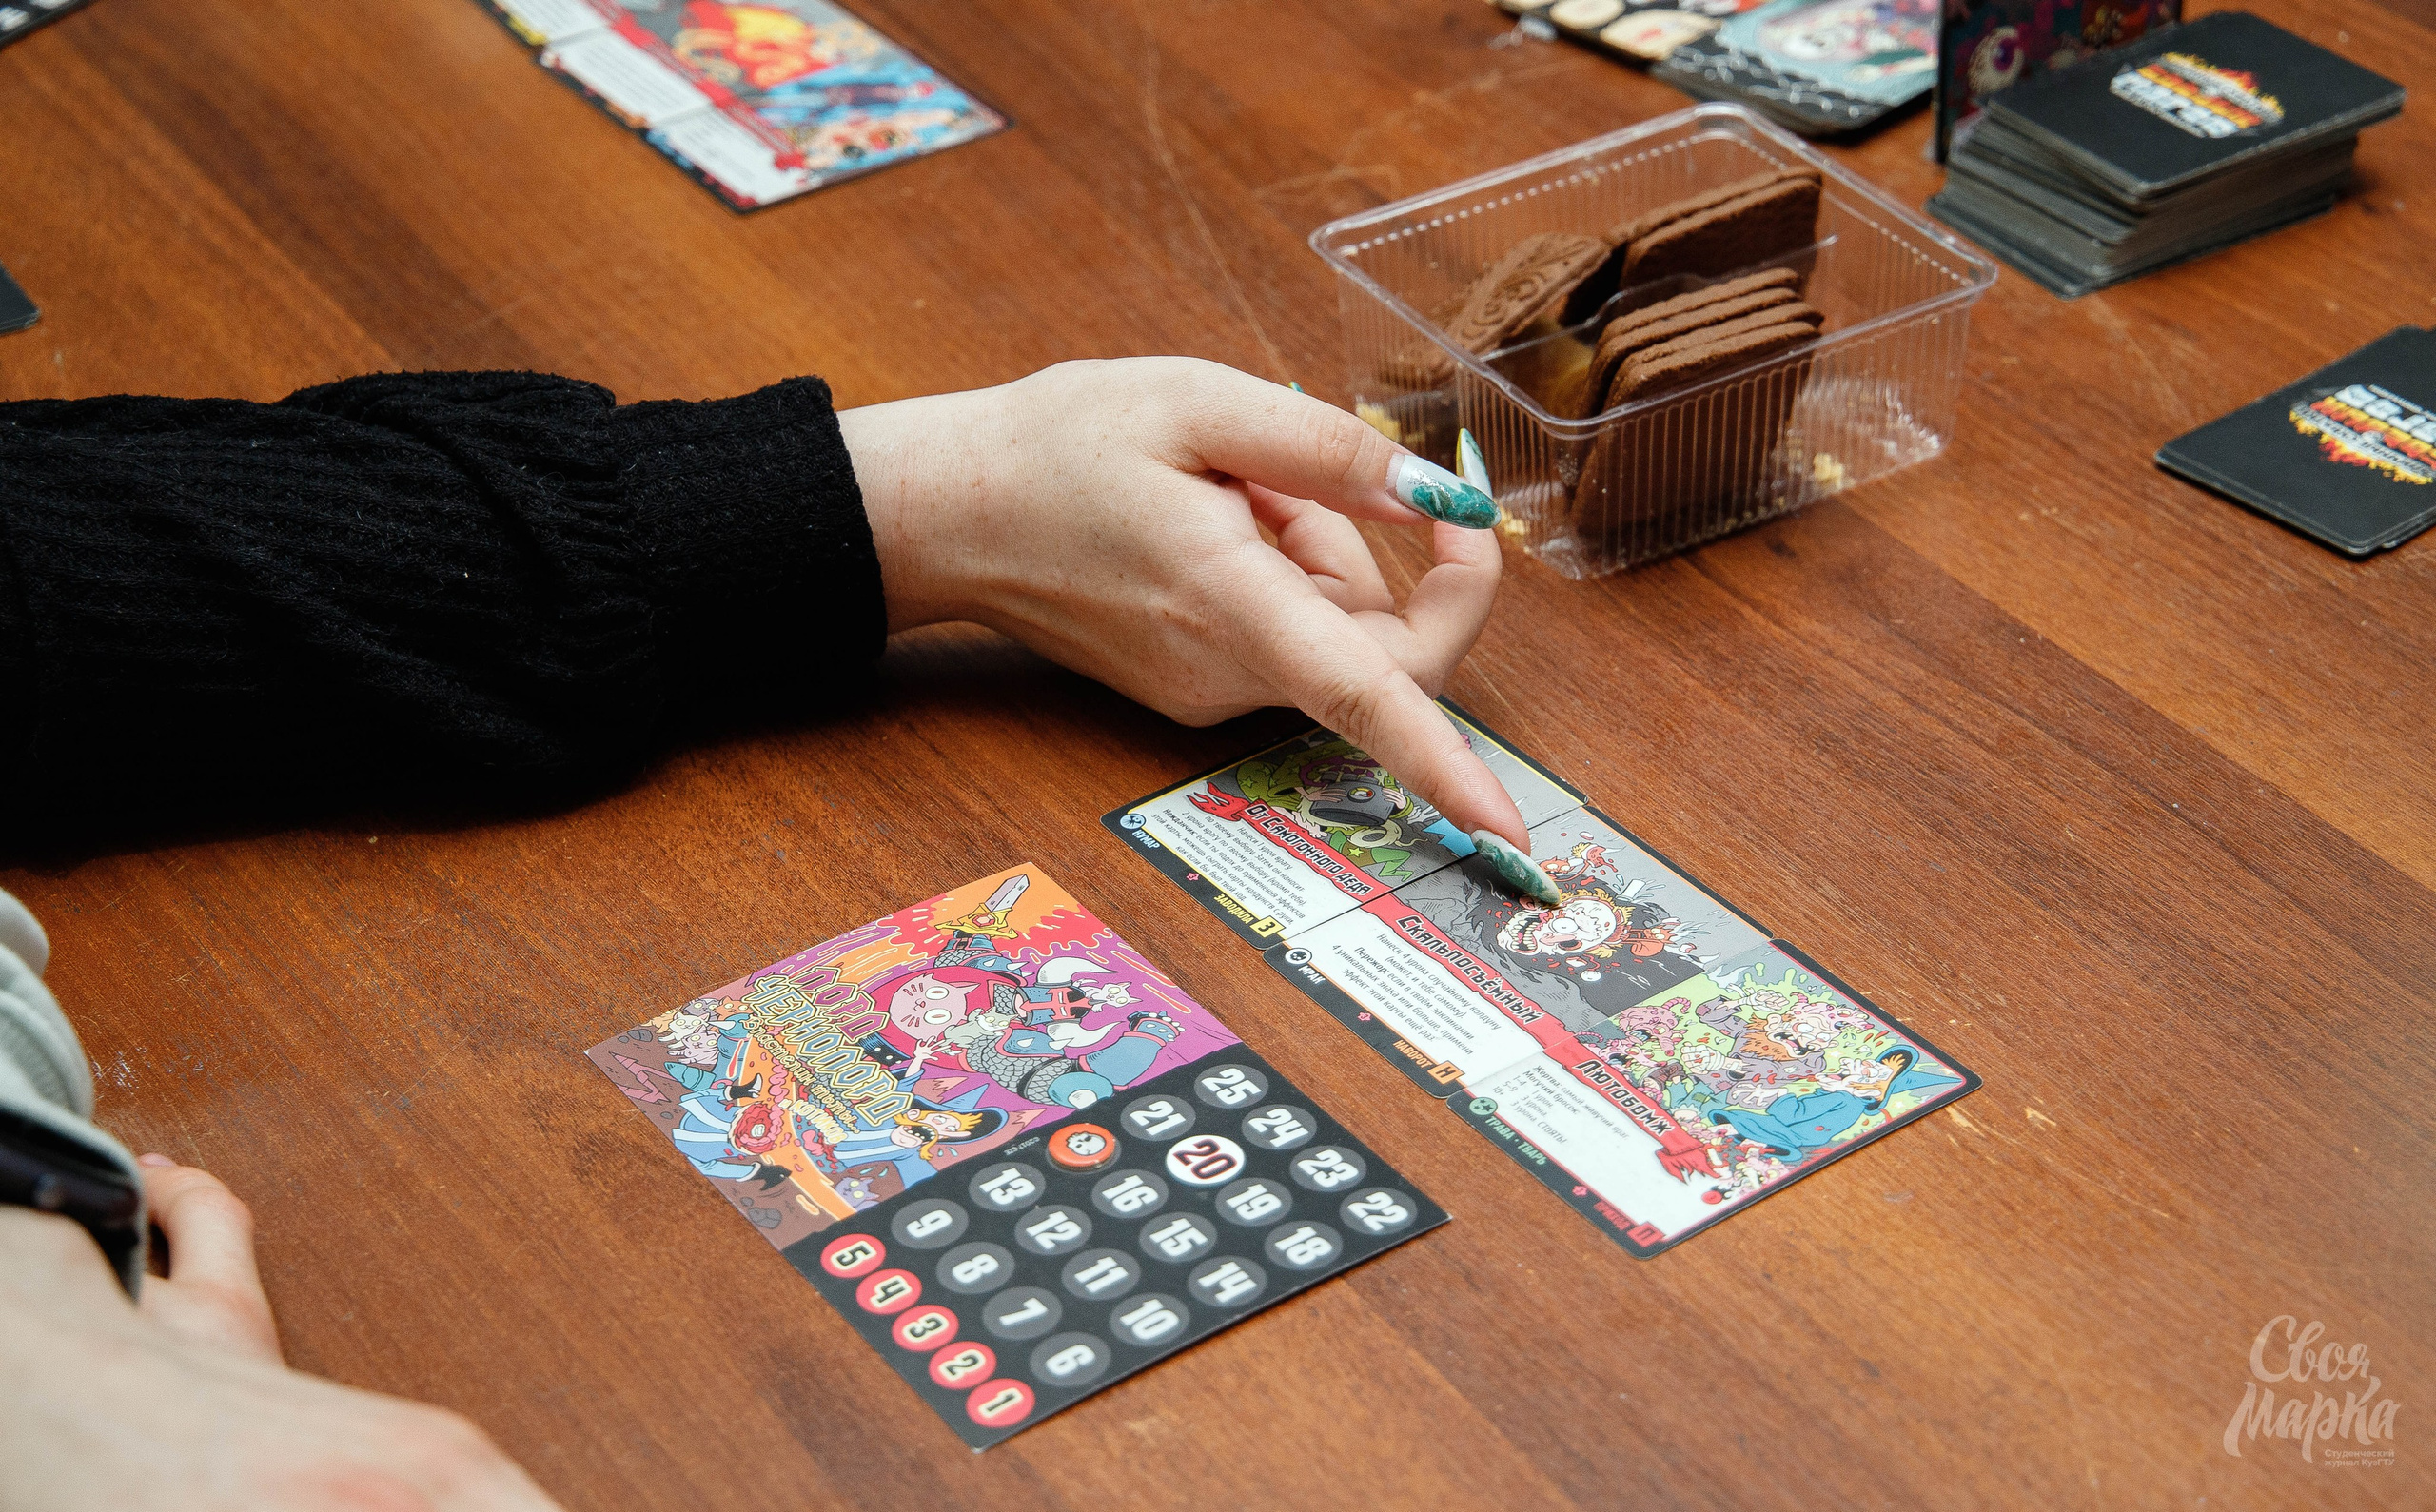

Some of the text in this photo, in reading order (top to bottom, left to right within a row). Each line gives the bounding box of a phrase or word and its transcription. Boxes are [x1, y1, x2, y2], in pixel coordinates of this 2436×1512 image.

[1151, 813, 1167, 824] этой
[1181, 836, 1208, 856] можешь
[1204, 854, 1229, 874] сыграть
[1226, 872, 1247, 887] карты
[1244, 886, 1274, 909] колдунств
[1175, 845, 1189, 854] как
[1186, 854, 1201, 865] если
[1198, 863, 1213, 872] бы
[1208, 870, 1225, 881] был
[1220, 880, 1237, 892] твой
[1184, 815, 1205, 829] урона
[1202, 827, 1221, 841] врагу
[1226, 845, 1249, 862] своему
[1246, 861, 1271, 878] выбору
[1267, 876, 1291, 894] (кроме
[1196, 835, 1211, 846] если
[1215, 851, 1236, 866] подох
[1241, 871, 1277, 897] применения
[1274, 897, 1305, 918] эффектов
[1211, 821, 1234, 838] твоему
[1254, 854, 1275, 868] Затем
[1237, 827, 1260, 843] Нанеси
[1258, 845, 1276, 857] урон
[1273, 856, 1292, 870] врагу
[1212, 894, 1254, 923] ЗАВОДИЛА
[1298, 965, 1324, 983] МРАК
[1335, 950, 1379, 981] уникальных
[1376, 980, 1400, 997] знака
[1397, 996, 1413, 1009] или
[1411, 1007, 1443, 1030] больше,
[1439, 1030, 1473, 1054] примени
[1341, 969, 1370, 989] эффект
[1365, 987, 1387, 1002] этой
[1381, 1000, 1407, 1019] карты
[1404, 1016, 1423, 1031] ещё
[1353, 947, 1390, 973] Пережор:
[1386, 972, 1405, 987] если
[1408, 990, 1434, 1008] твоём
[1432, 1008, 1473, 1039] заклинании
[1377, 934, 1404, 953] Нанеси
[1405, 957, 1430, 975] урона
[1426, 974, 1471, 1007] случайному
[1468, 1007, 1500, 1030] колдуну
[1385, 956, 1415, 977] (может,
[1418, 980, 1437, 994] тебе
[1433, 993, 1467, 1018] самому).
[1393, 1040, 1430, 1068] НАВОРОТ
[1522, 1070, 1580, 1114] Могучий бросок:
[1533, 1066, 1562, 1088] Жертва:
[1560, 1086, 1585, 1105] самый
[1581, 1104, 1613, 1127] живучий
[1201, 1068, 1409, 1232] 25 24 23 22
[1484, 1116, 1548, 1165] ТРАВА ТВАРЬ
[1130, 1100, 1333, 1266] 21 20 19 18
[978, 1168, 1180, 1342] 13 12 11 10
[1101, 1174, 1257, 1304] 16 15 14
[829, 1240, 1025, 1421] 5 4 3 2 1
[906, 1209, 1096, 1377] 9 8 7 6
